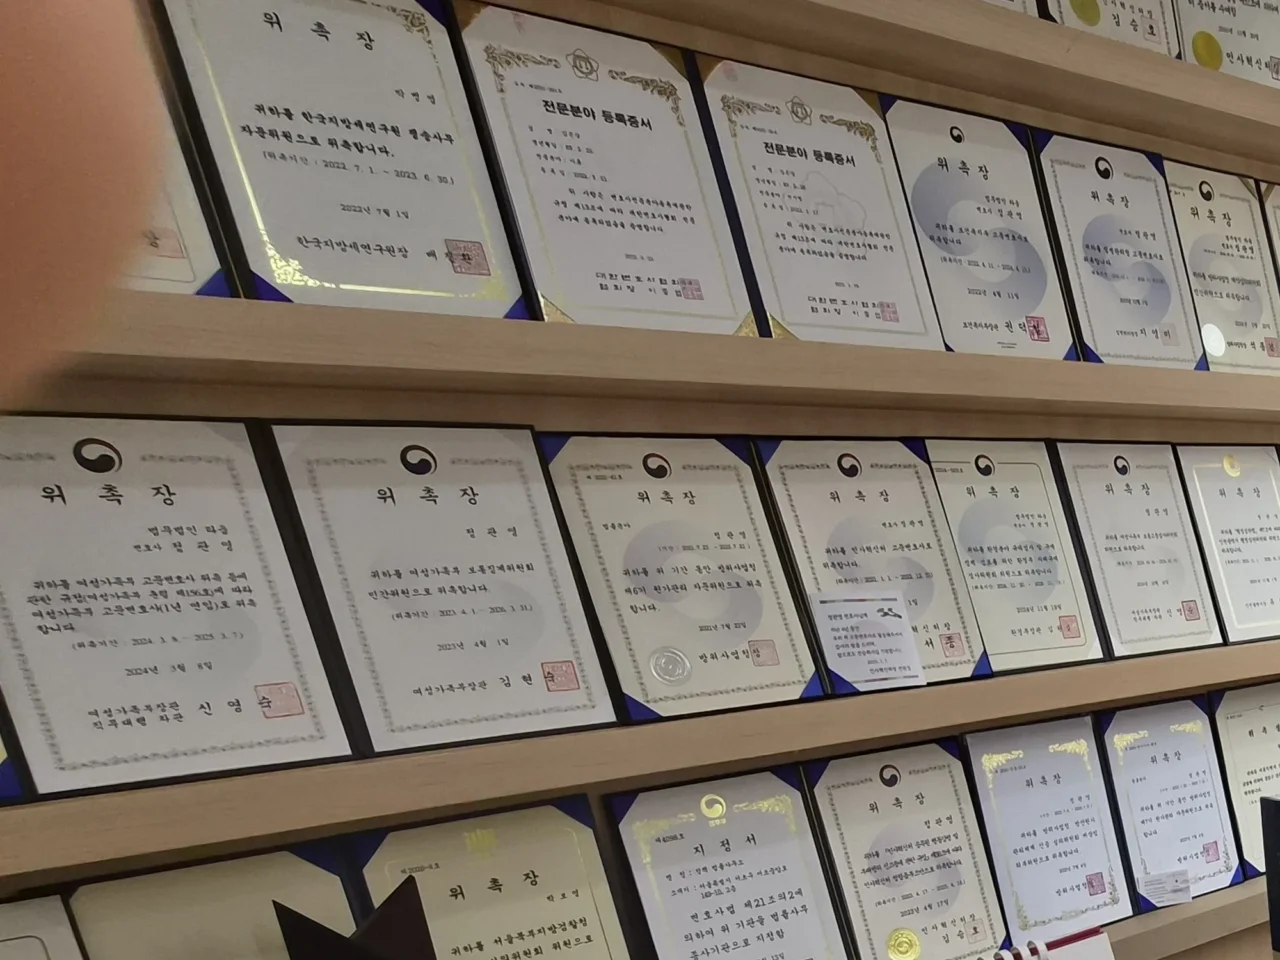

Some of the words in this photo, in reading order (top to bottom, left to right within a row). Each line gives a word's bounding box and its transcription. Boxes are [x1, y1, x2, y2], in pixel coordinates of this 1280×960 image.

[542, 100, 596, 121] 전문분야
[601, 111, 653, 131] 등록증서
[763, 141, 808, 160] 전문분야
[813, 149, 857, 168] 등록증서
[689, 904, 736, 924] 변호사법
[744, 887, 804, 910] 제21조의2에
[451, 939, 485, 958] 귀하를
[492, 916, 589, 948] 서울북부지방검찰청
[551, 933, 595, 953] 위원으로
[683, 927, 715, 943] 의하여
[735, 915, 766, 931] 기관을
